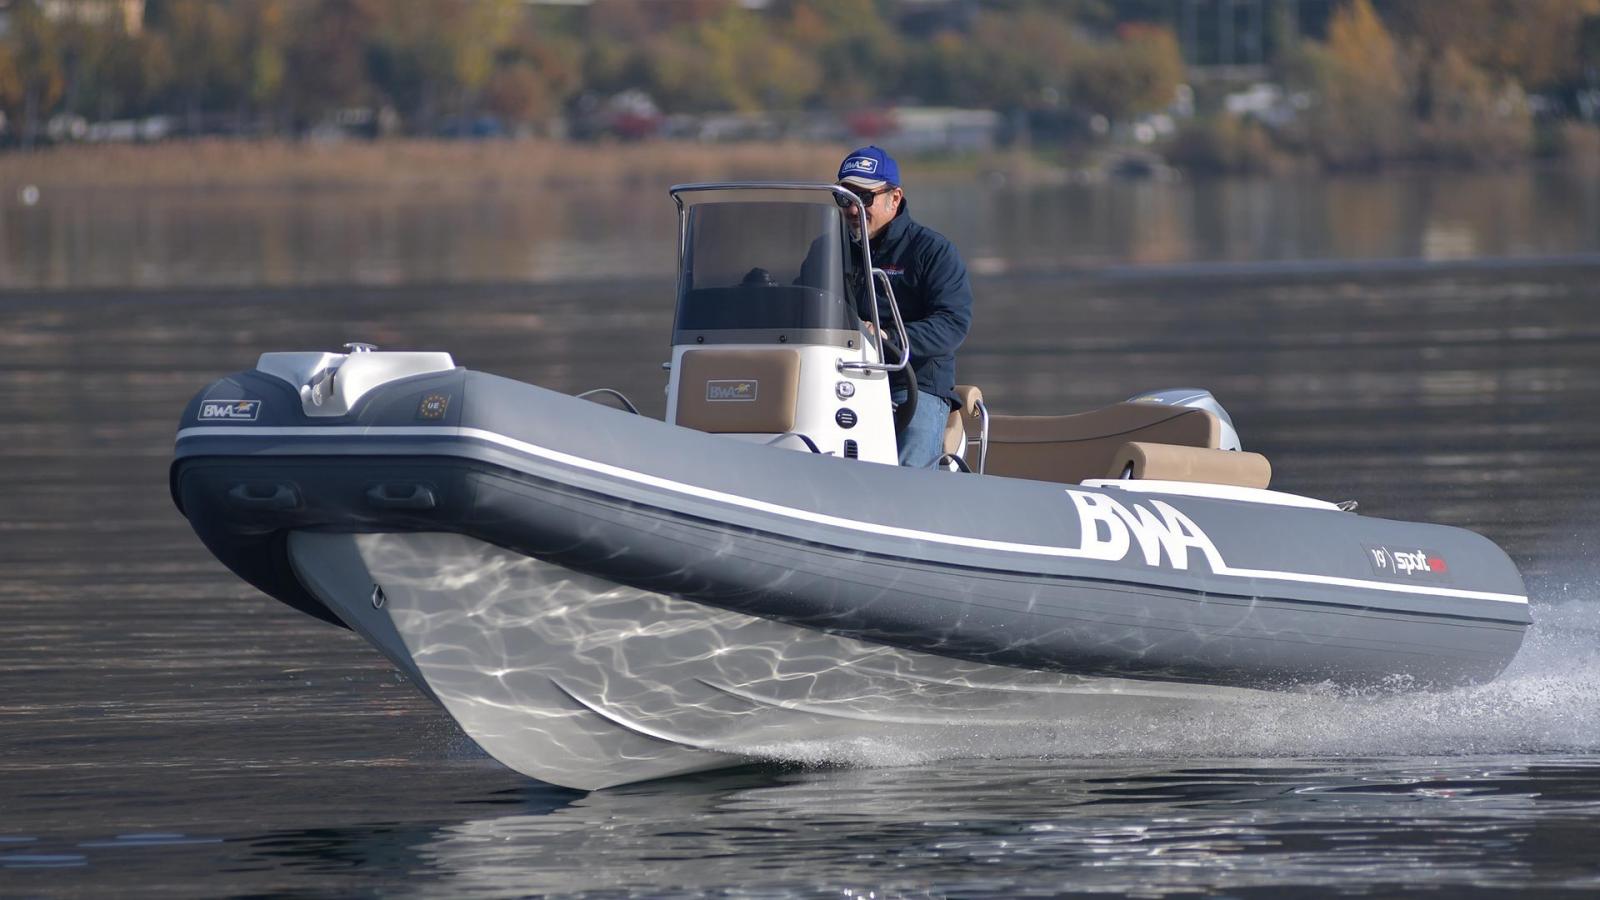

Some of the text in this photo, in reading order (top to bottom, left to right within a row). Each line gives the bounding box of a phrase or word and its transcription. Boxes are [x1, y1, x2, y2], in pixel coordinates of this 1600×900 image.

[710, 386, 735, 398] BWA
[203, 404, 234, 417] BWA
[1065, 489, 1223, 574] BWA
